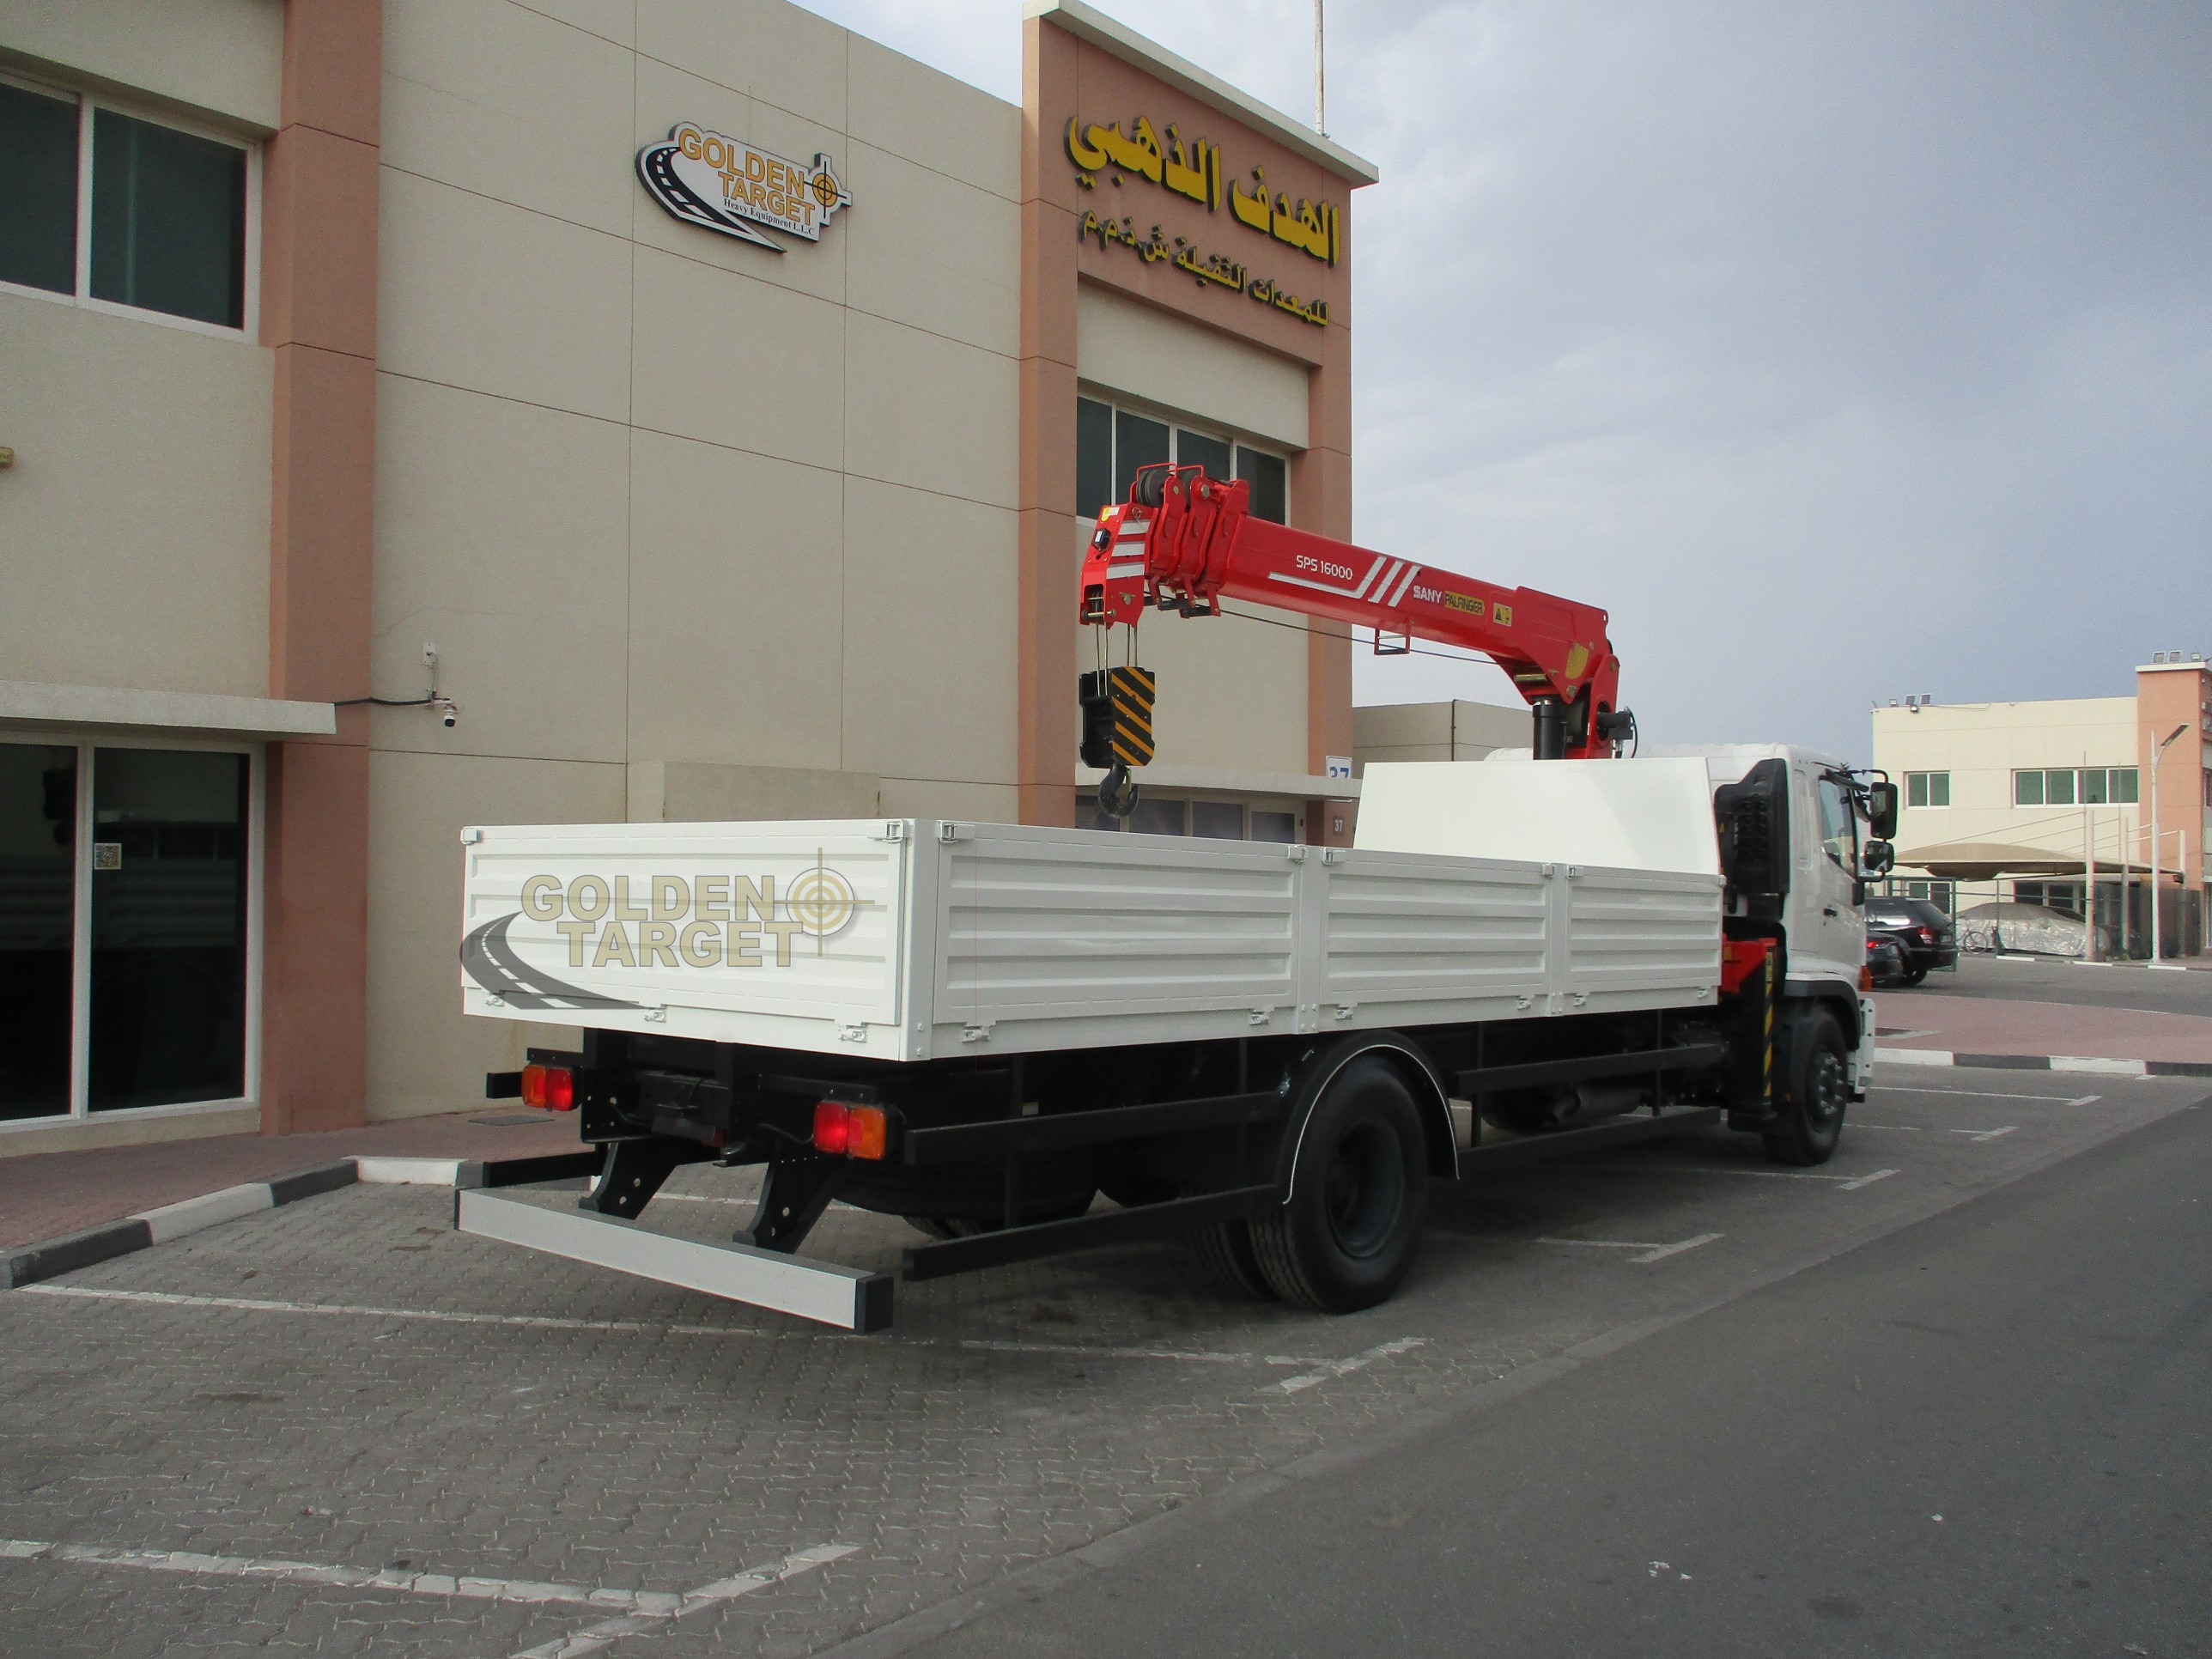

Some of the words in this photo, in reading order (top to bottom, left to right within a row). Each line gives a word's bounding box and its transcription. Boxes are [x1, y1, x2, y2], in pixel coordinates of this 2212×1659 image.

[678, 129, 805, 199] GOLDEN
[1064, 114, 1221, 214] الذهبي
[718, 171, 816, 226] TARGET
[724, 198, 749, 216] Heavy
[750, 207, 791, 229] Equipment
[1228, 165, 1340, 269] الهدف
[1171, 236, 1248, 294] الثقيلة
[1249, 278, 1330, 327] للمعدات
[1296, 555, 1318, 572] SPS
[1320, 560, 1353, 581] 16000
[1413, 585, 1443, 605] SANY
[1444, 592, 1484, 615] PALFINGER
[1334, 819, 1343, 831] 37
